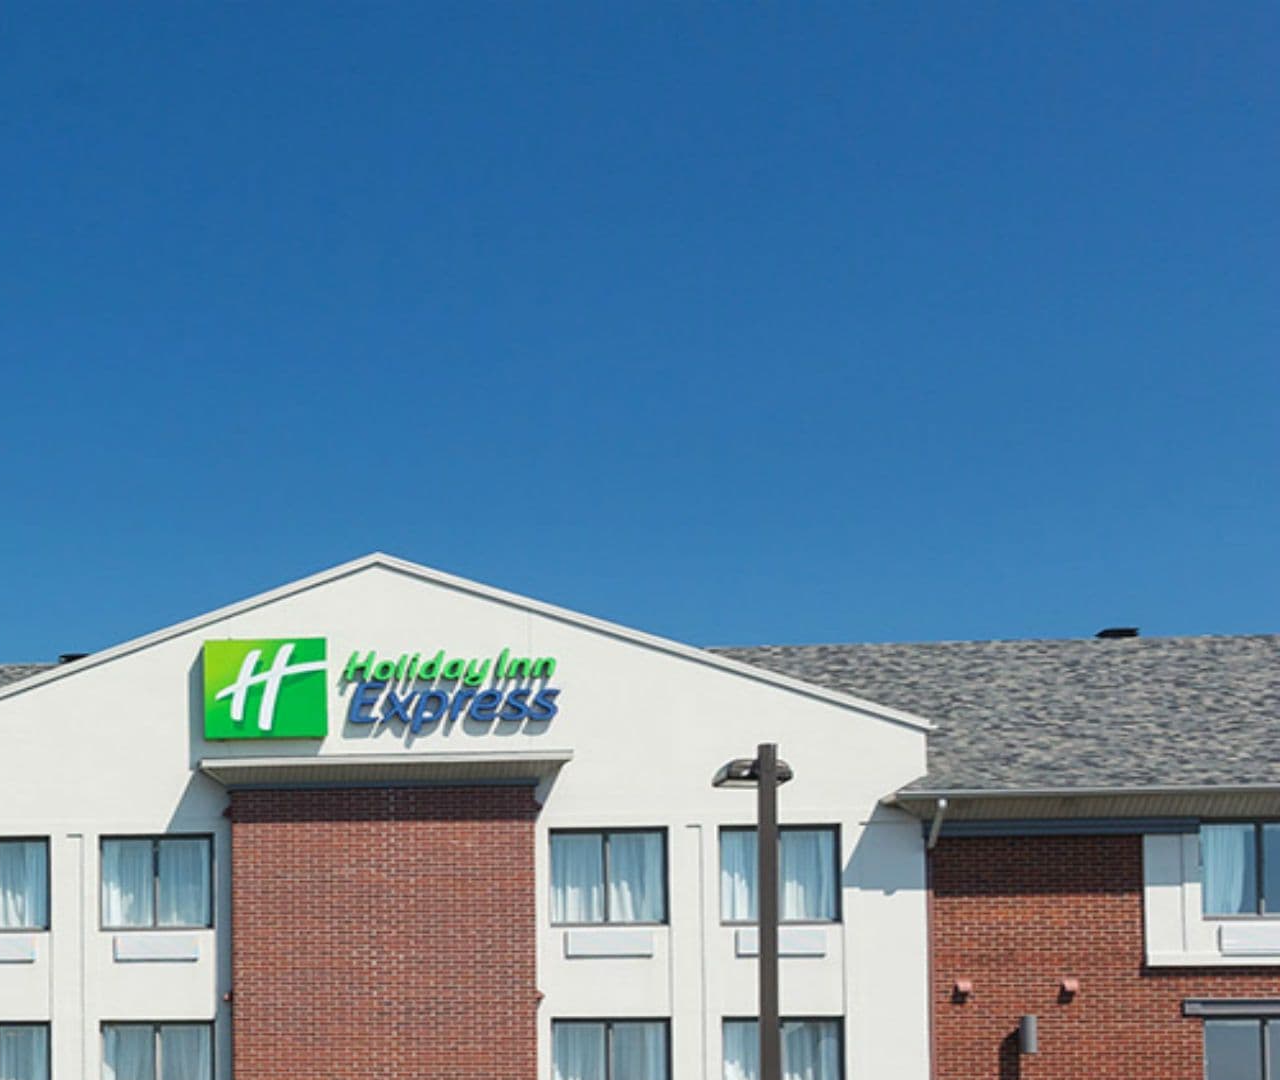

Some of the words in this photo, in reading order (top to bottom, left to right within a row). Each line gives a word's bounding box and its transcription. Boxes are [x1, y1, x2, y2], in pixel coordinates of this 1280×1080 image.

[214, 642, 327, 730] H
[344, 650, 490, 686] Holiday
[493, 647, 557, 680] Inn
[348, 681, 561, 734] Express
